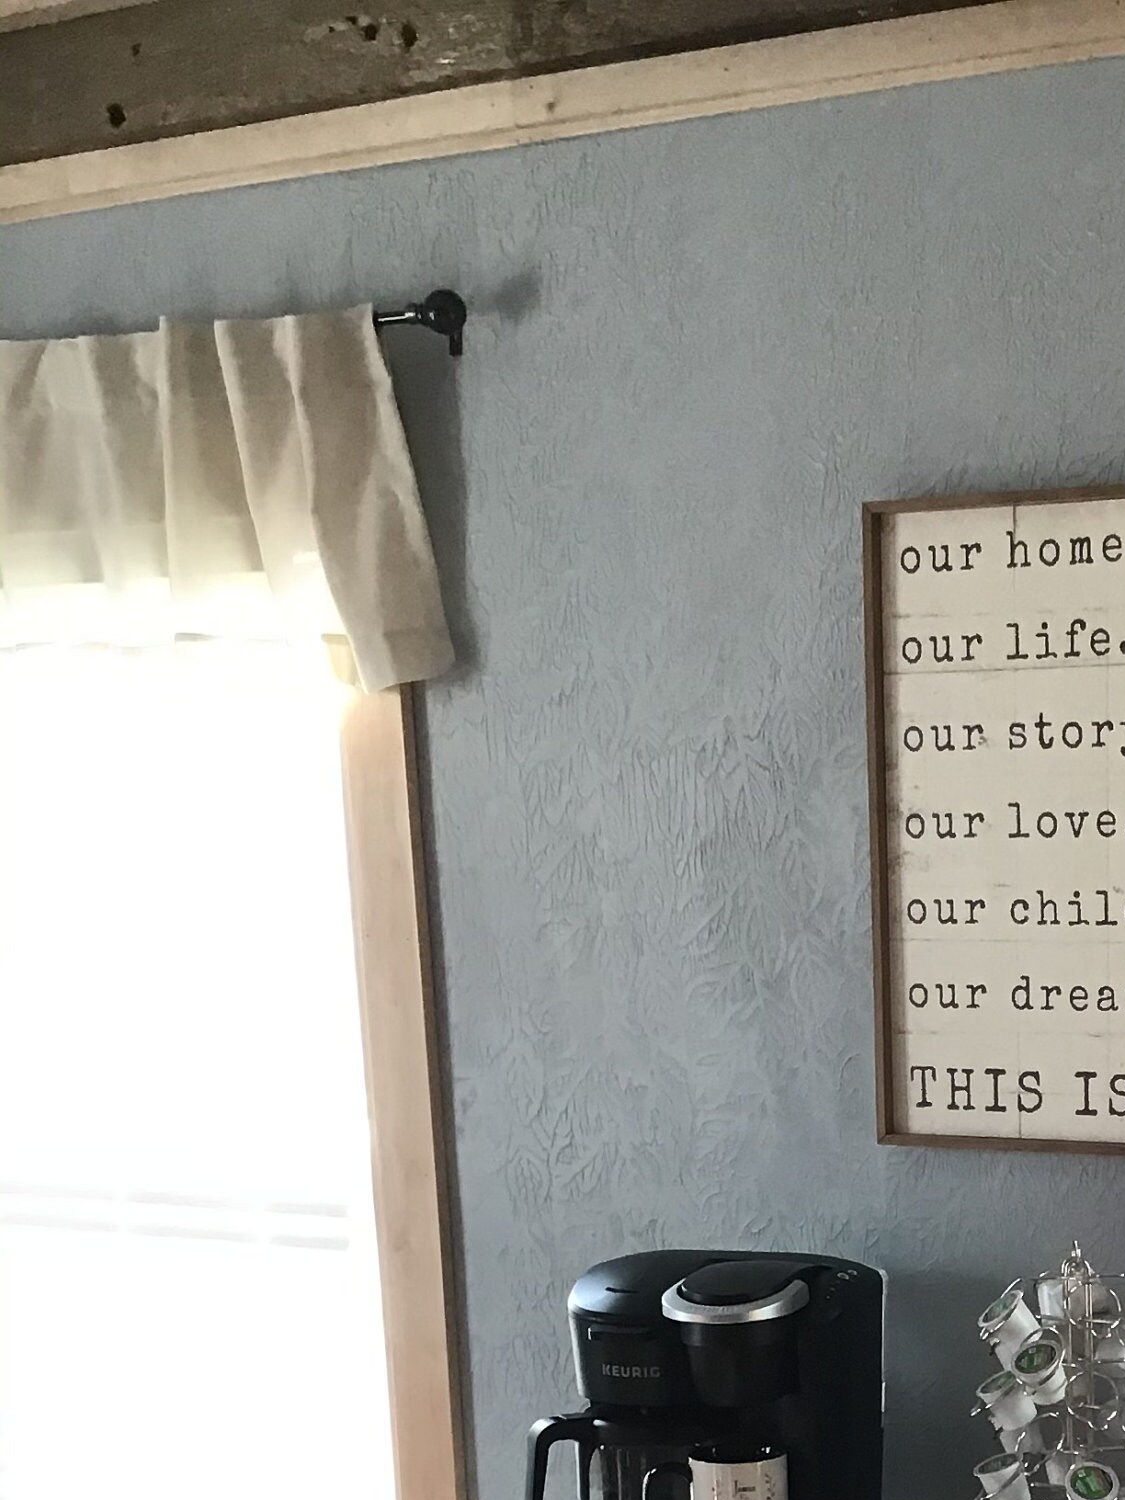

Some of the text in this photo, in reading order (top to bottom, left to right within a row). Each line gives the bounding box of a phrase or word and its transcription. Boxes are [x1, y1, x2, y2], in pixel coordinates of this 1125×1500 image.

[900, 542, 982, 574] our
[902, 633, 983, 664] our
[903, 724, 984, 753] our
[905, 812, 985, 839] our
[907, 898, 986, 925] our
[908, 983, 987, 1009] our
[910, 1065, 1043, 1114] THIS
[601, 1363, 661, 1379] KEURIG
